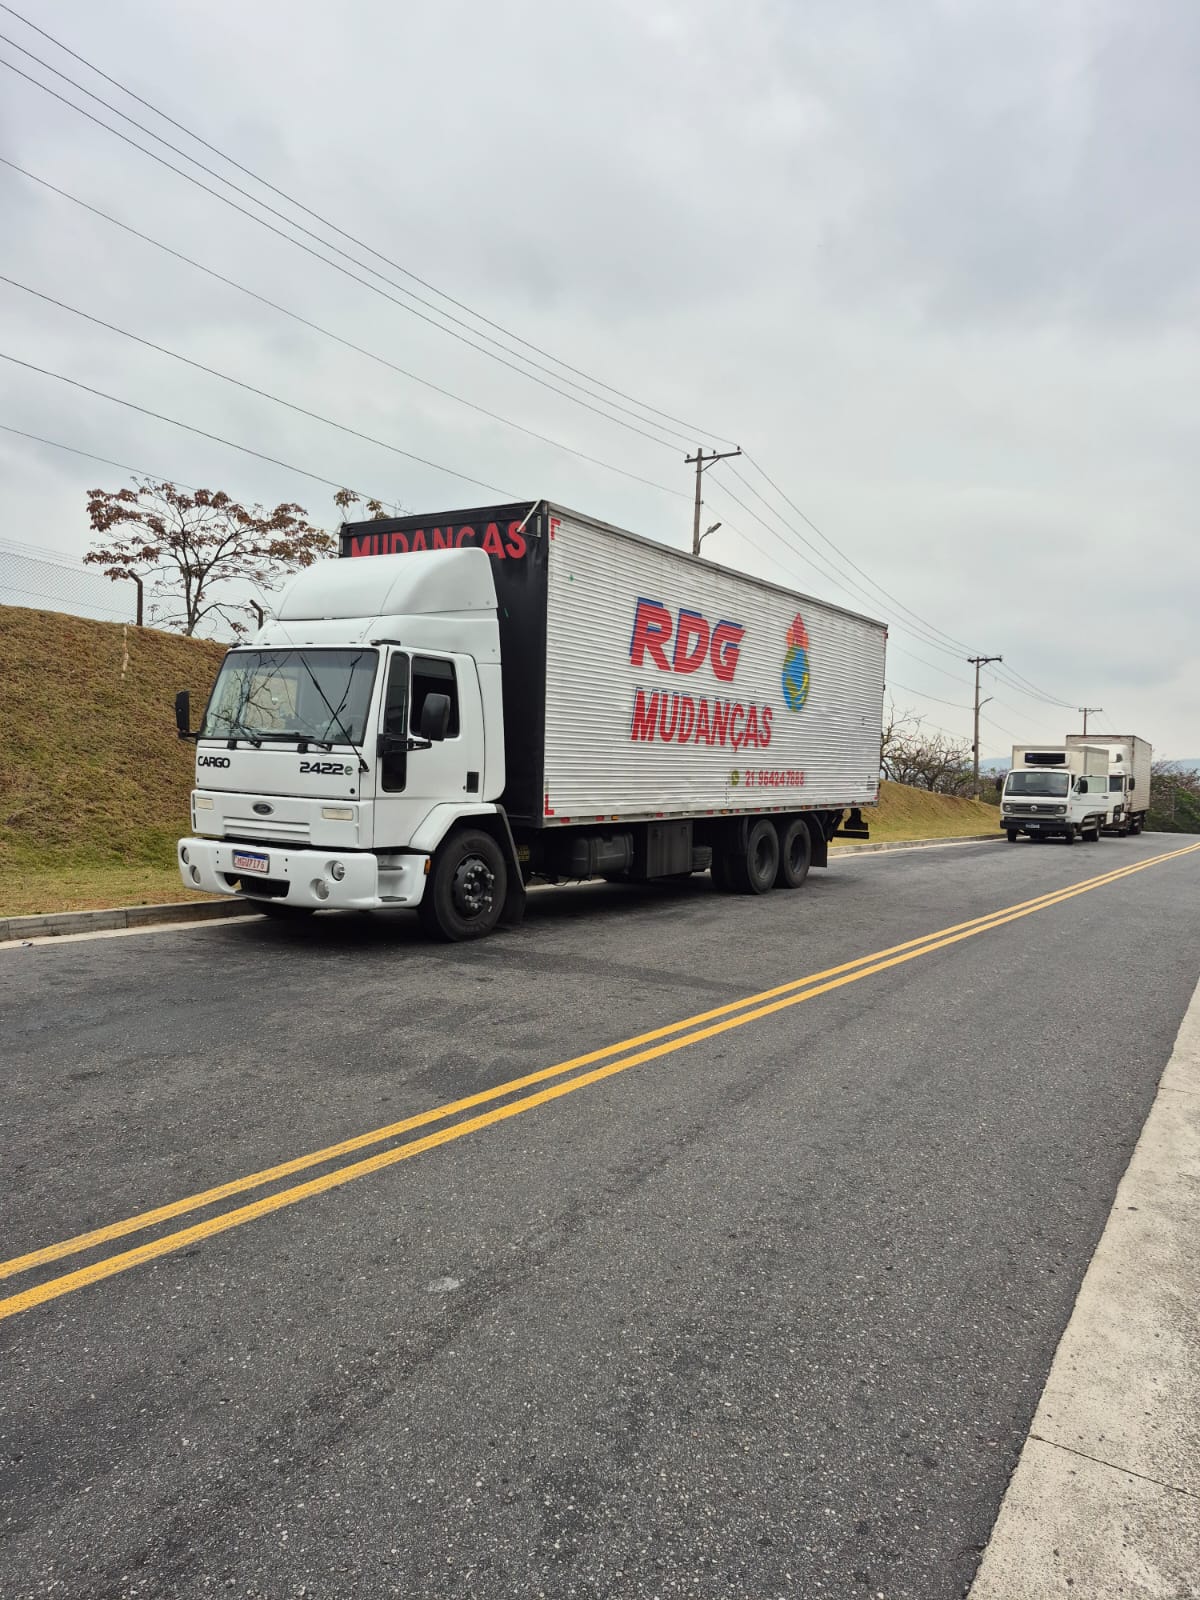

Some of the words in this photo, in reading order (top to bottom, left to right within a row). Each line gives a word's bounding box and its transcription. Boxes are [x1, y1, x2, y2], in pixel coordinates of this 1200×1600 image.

[629, 597, 746, 682] RDG
[631, 686, 773, 752] MUDANÇAS
[198, 756, 231, 768] CARGO
[300, 761, 353, 776] 2422e
[745, 770, 755, 787] 21
